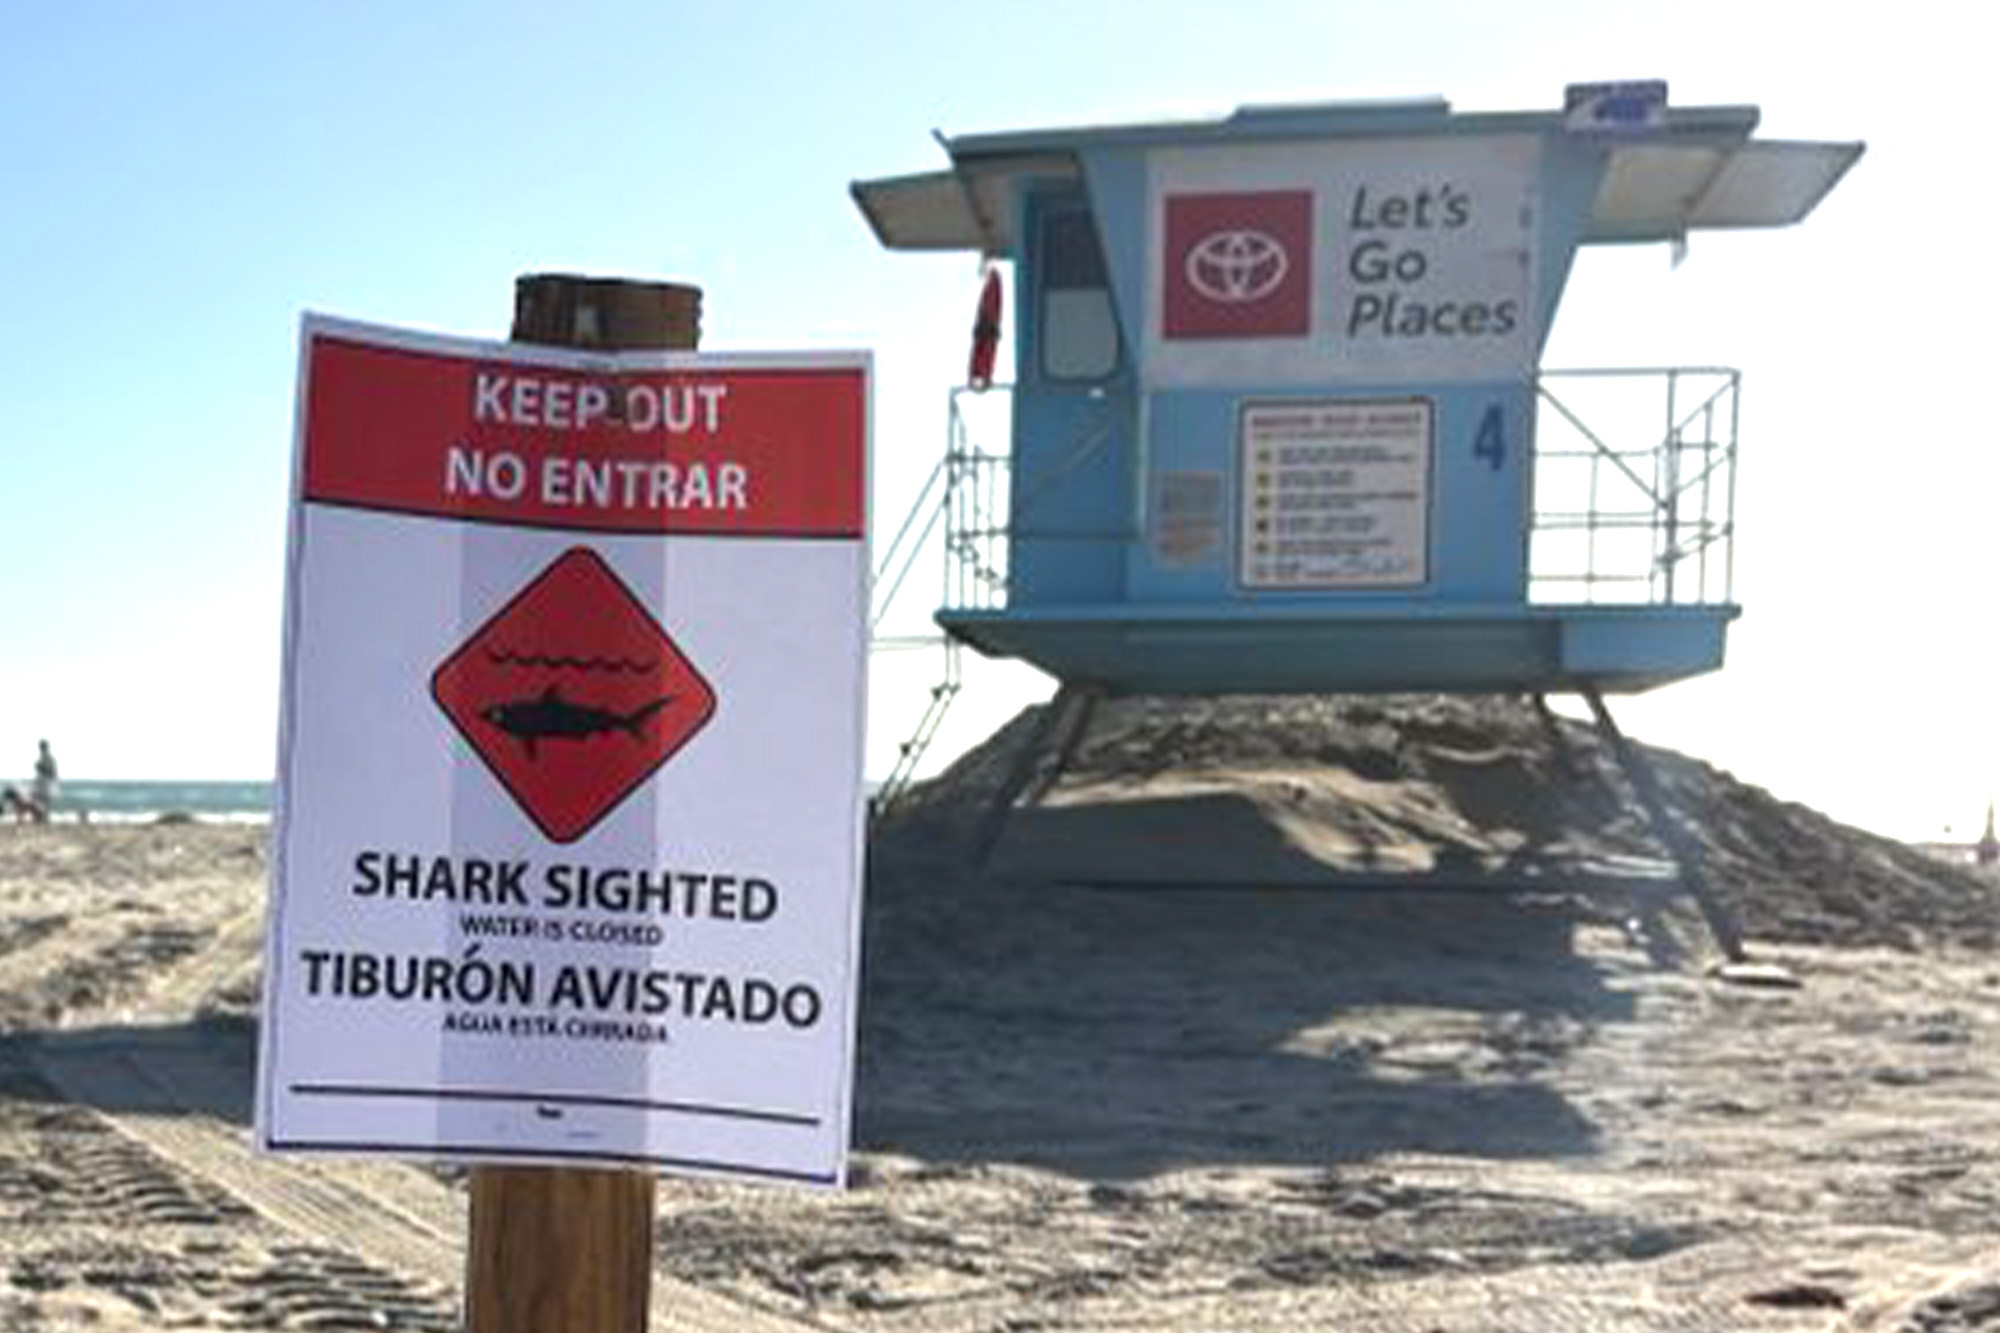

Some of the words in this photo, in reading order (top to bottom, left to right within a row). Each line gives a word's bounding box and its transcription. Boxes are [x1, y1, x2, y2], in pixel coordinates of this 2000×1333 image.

[1350, 240, 1427, 285] Go
[1349, 293, 1517, 338] Places
[474, 374, 608, 428] KEEP
[626, 385, 727, 433] OUT
[1474, 404, 1505, 471] 4
[446, 447, 526, 499] NO
[542, 457, 747, 509] ENTRAR
[353, 851, 530, 906] SHARK
[543, 864, 778, 924] SIGHTED
[460, 914, 538, 938] WATER
[569, 920, 664, 947] CLOSED
[301, 942, 534, 1005] TIBURÓN
[549, 965, 822, 1029] AVISTADO
